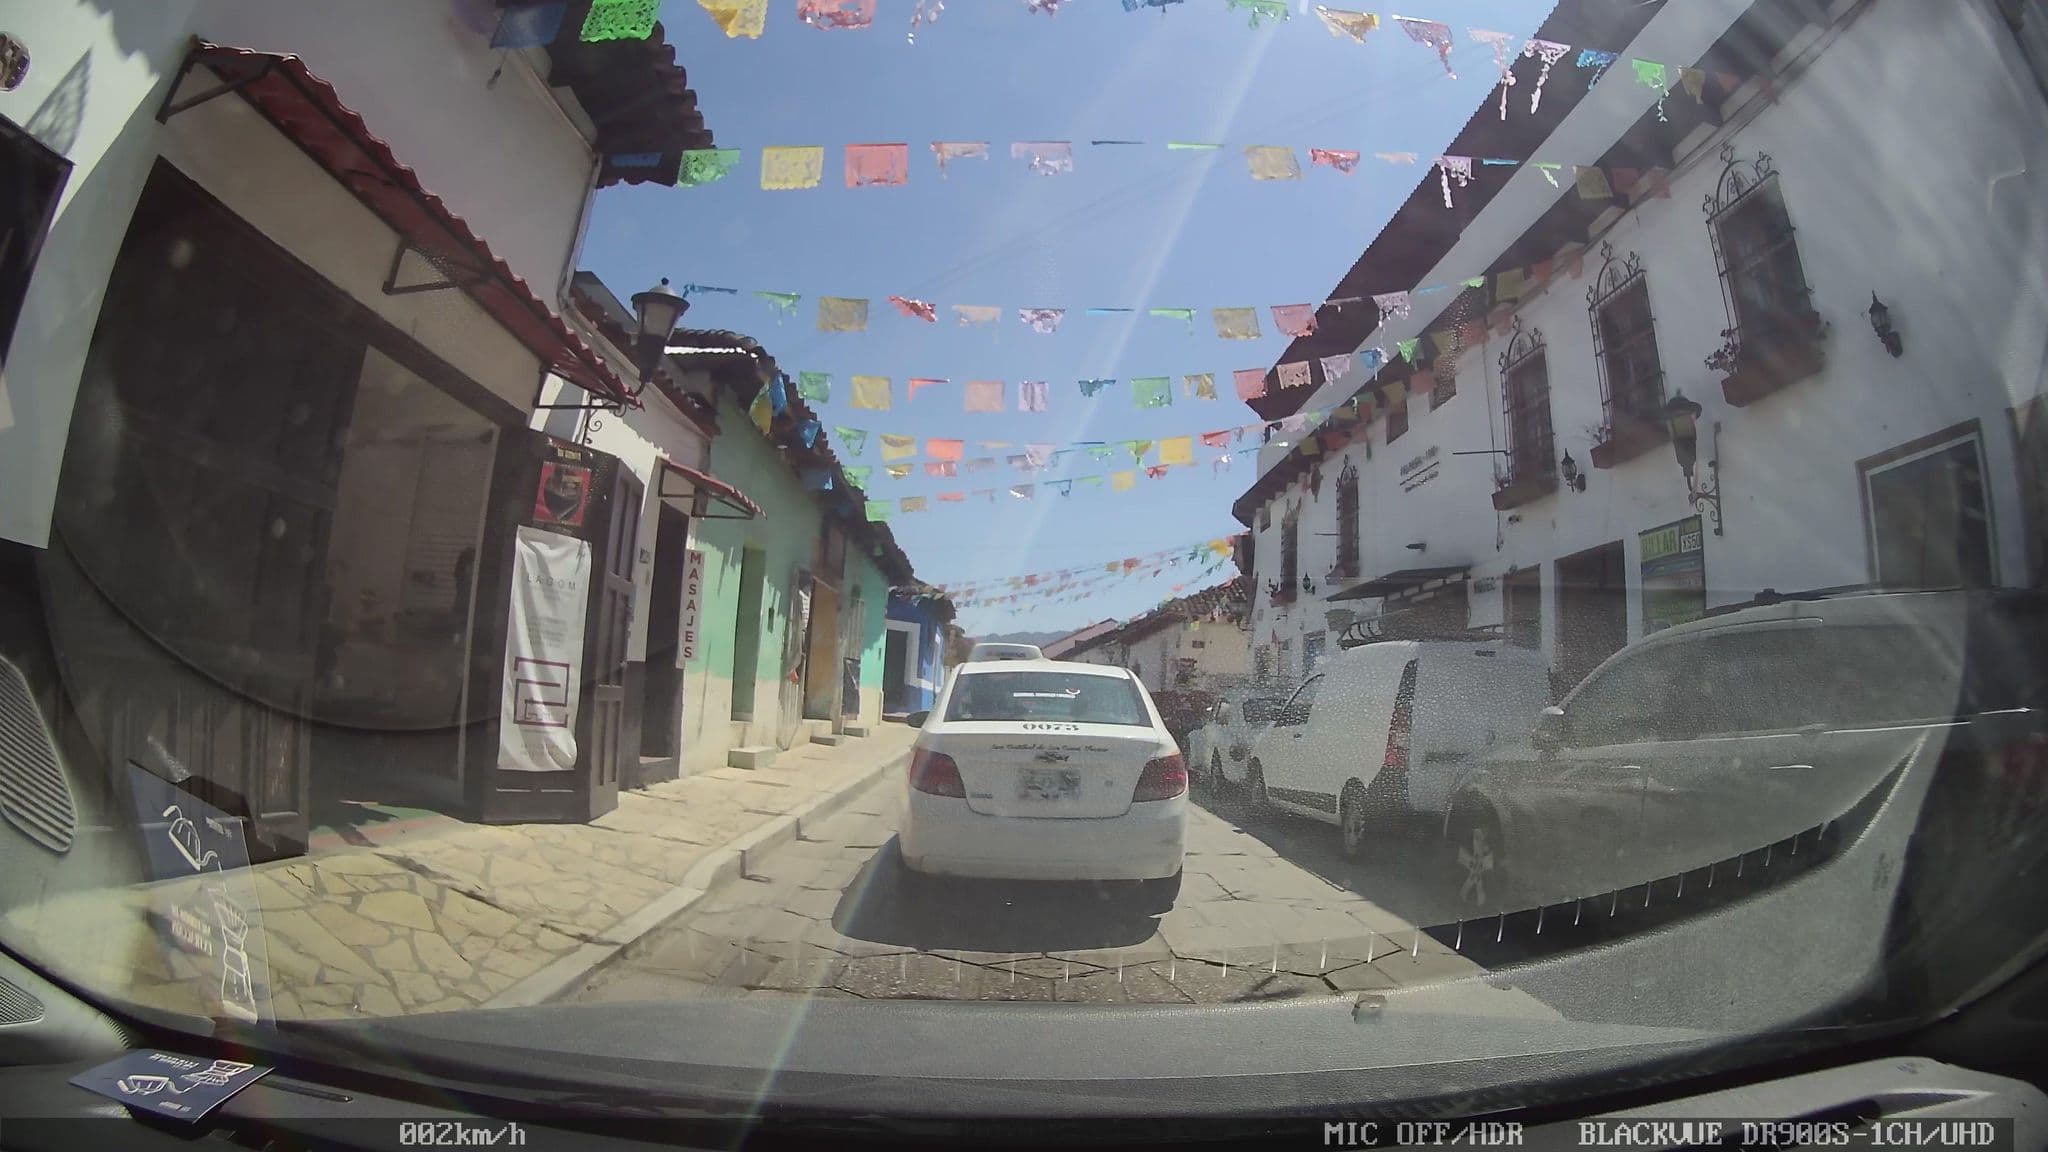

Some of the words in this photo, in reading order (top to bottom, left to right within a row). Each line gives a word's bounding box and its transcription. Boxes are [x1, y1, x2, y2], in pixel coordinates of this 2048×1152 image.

[1641, 529, 1677, 555] BILLAR
[526, 573, 577, 592] LAGOM
[683, 551, 702, 659] MASAJES
